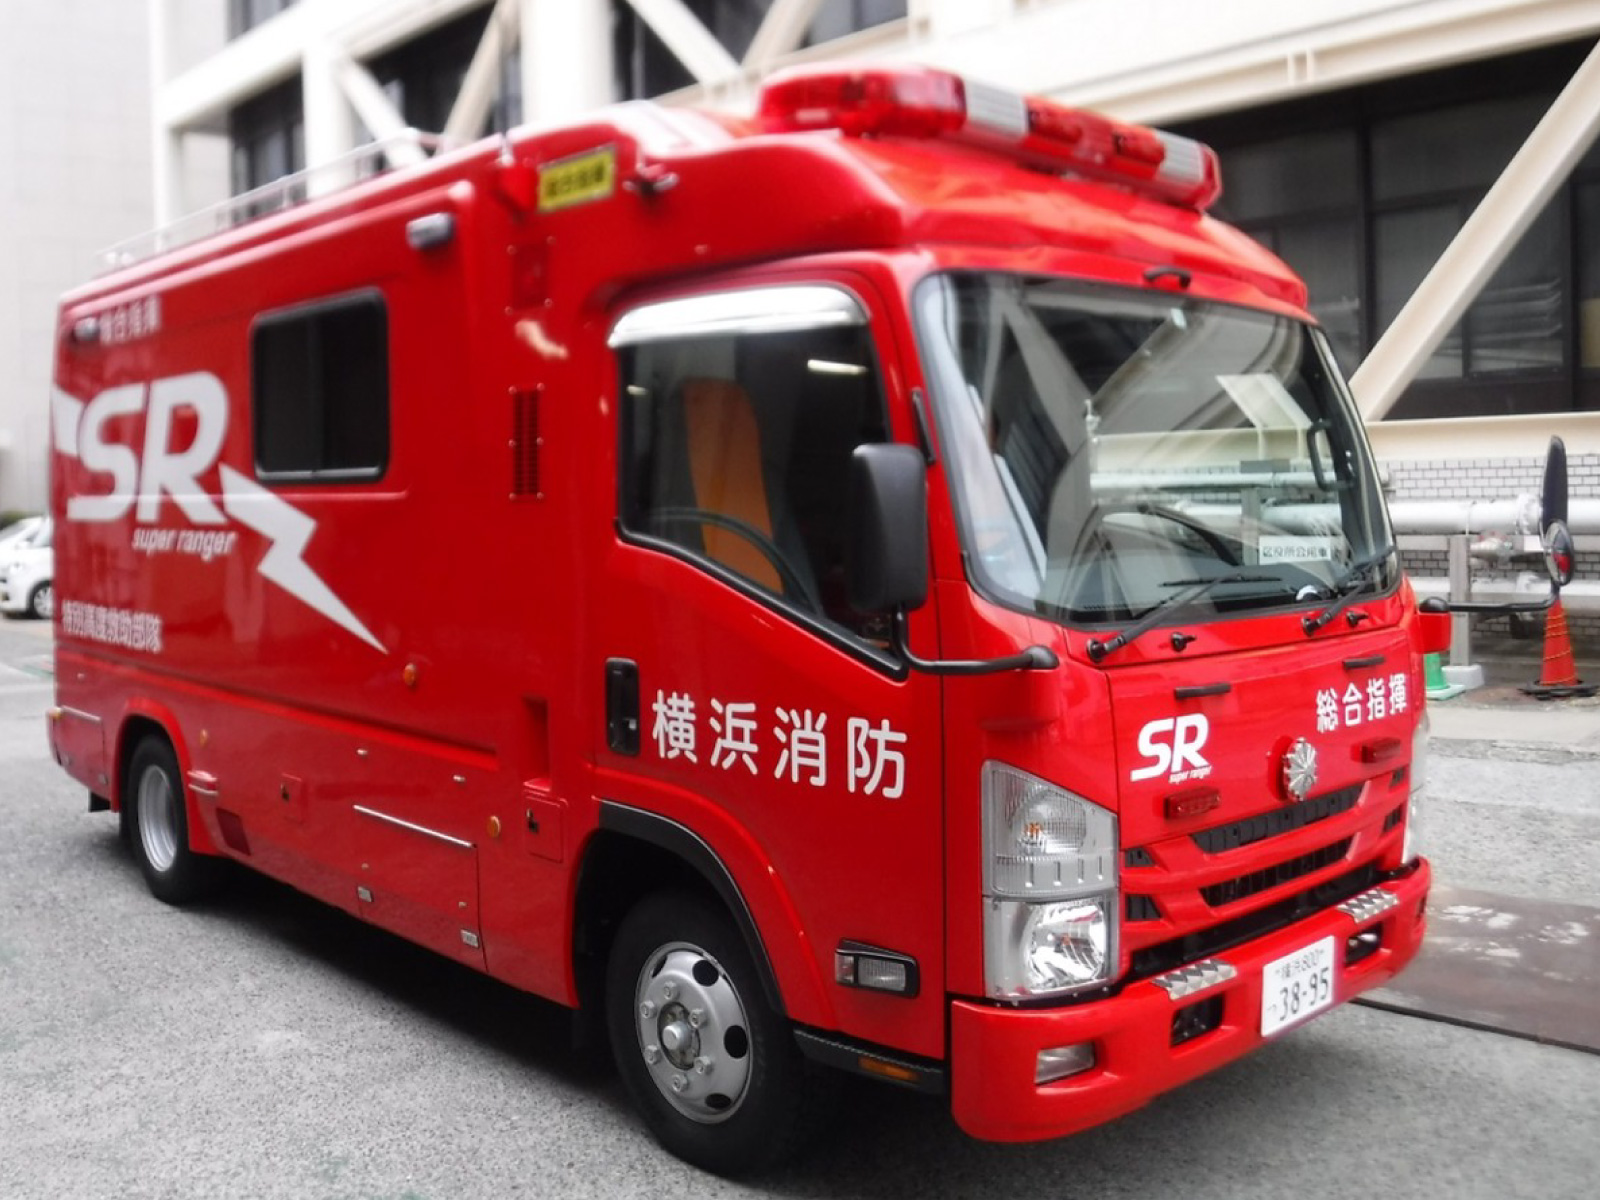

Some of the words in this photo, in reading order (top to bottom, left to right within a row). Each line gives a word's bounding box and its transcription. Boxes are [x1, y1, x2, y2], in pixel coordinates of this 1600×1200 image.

[66, 371, 230, 524] SR
[132, 528, 177, 556] super
[177, 530, 237, 561] ranger
[1316, 673, 1408, 733] 総合指揮
[652, 689, 908, 799] 横浜消防
[1130, 713, 1211, 782] SR
[1279, 966, 1329, 1021] 38-95
